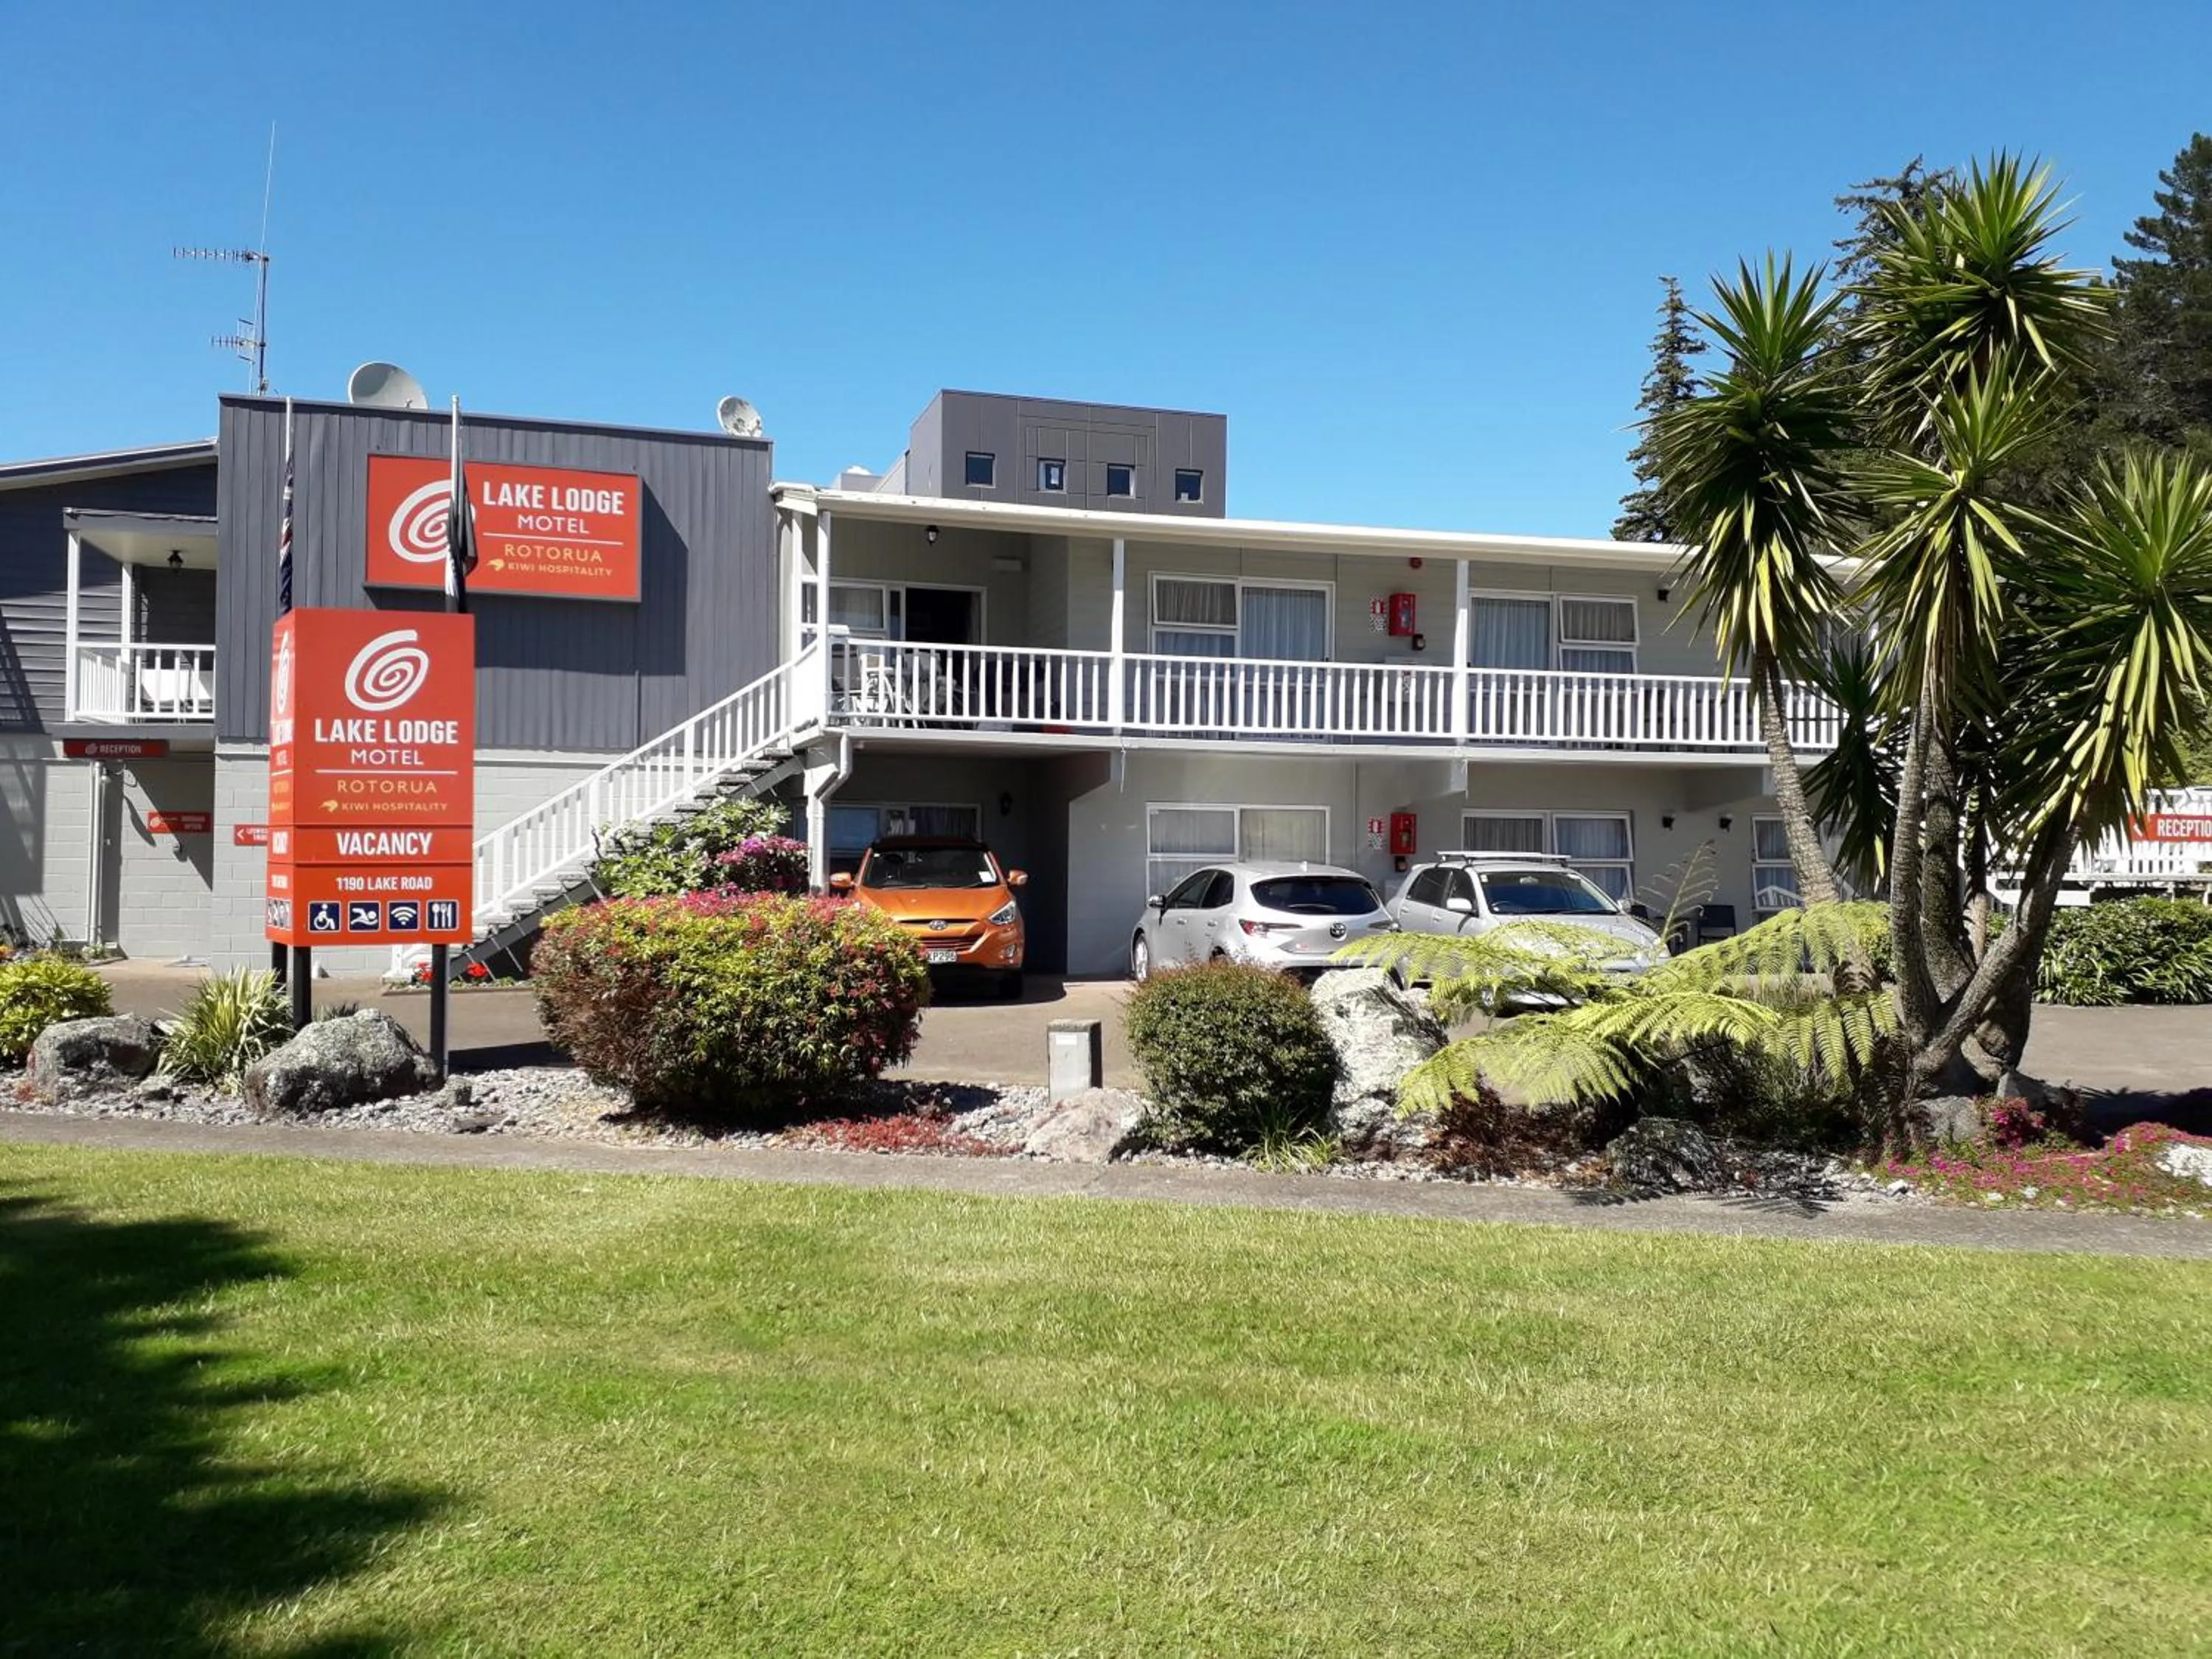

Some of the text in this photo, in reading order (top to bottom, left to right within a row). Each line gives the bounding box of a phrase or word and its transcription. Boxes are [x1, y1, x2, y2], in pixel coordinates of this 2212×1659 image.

[483, 481, 625, 515] LAKE LODGE
[518, 514, 590, 534] MOTEL
[504, 543, 603, 563] ROTORUA
[507, 563, 613, 577] KIWI HOSPITALITY
[314, 719, 378, 743] LAKE
[384, 720, 459, 744] LODGE
[100, 744, 142, 754] RECEPTION
[351, 749, 425, 765] MOTEL
[337, 779, 438, 793] ROTORUA
[341, 802, 448, 811] KIWI HOSPITALITY
[336, 832, 433, 855] VACANCY
[336, 877, 433, 891] 1190 LAKE ROAD
